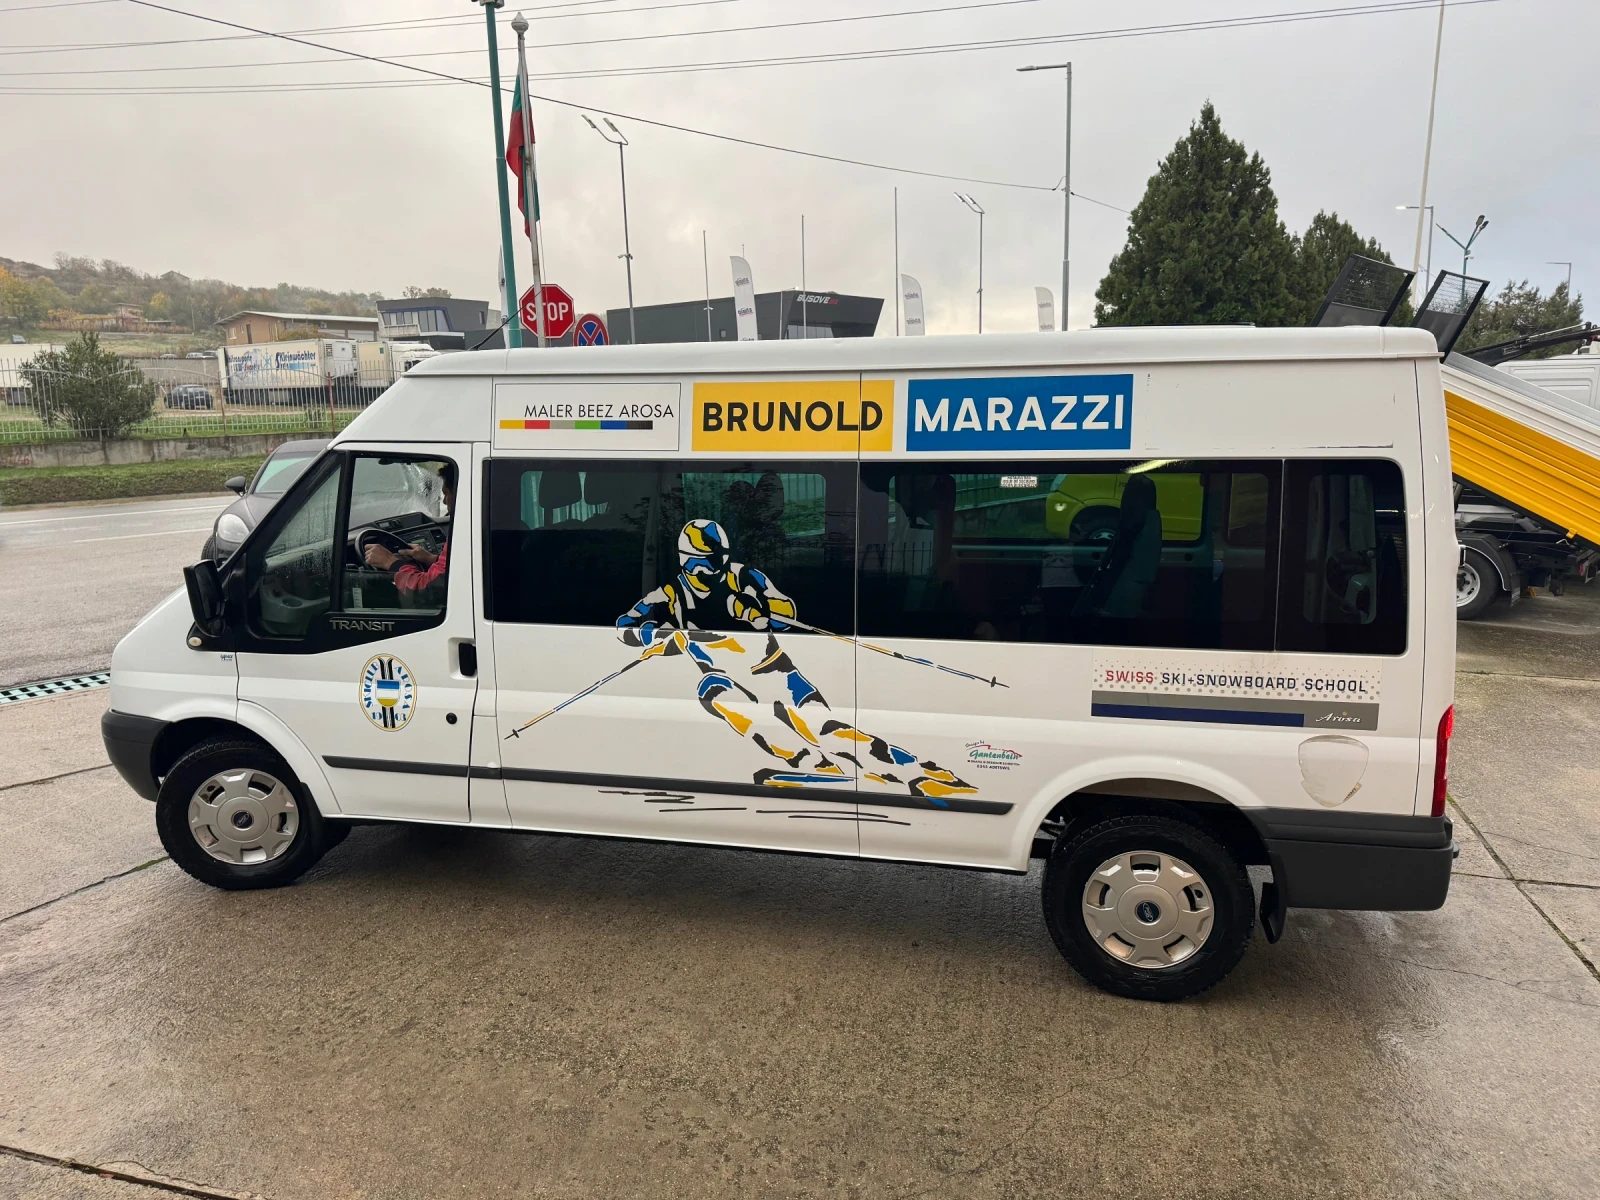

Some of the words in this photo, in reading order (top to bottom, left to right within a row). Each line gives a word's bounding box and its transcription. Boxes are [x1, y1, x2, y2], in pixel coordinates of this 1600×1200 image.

[526, 302, 569, 322] SOP
[524, 404, 573, 418] MALER
[578, 404, 613, 418] BEEZ
[619, 404, 674, 418] AROSA
[702, 400, 883, 432] BRUNOLD
[914, 394, 1125, 432] MARAZZI
[329, 619, 395, 632] TRANSIT
[363, 662, 379, 708] SKICLUB
[394, 666, 413, 709] AROSA
[1105, 670, 1154, 683] SWISS
[1161, 672, 1297, 690] SKI+SNOWBOARD
[1304, 678, 1367, 693] SCHOOL
[1315, 712, 1362, 723] Arosa
[969, 749, 1019, 760] Gantenbein
